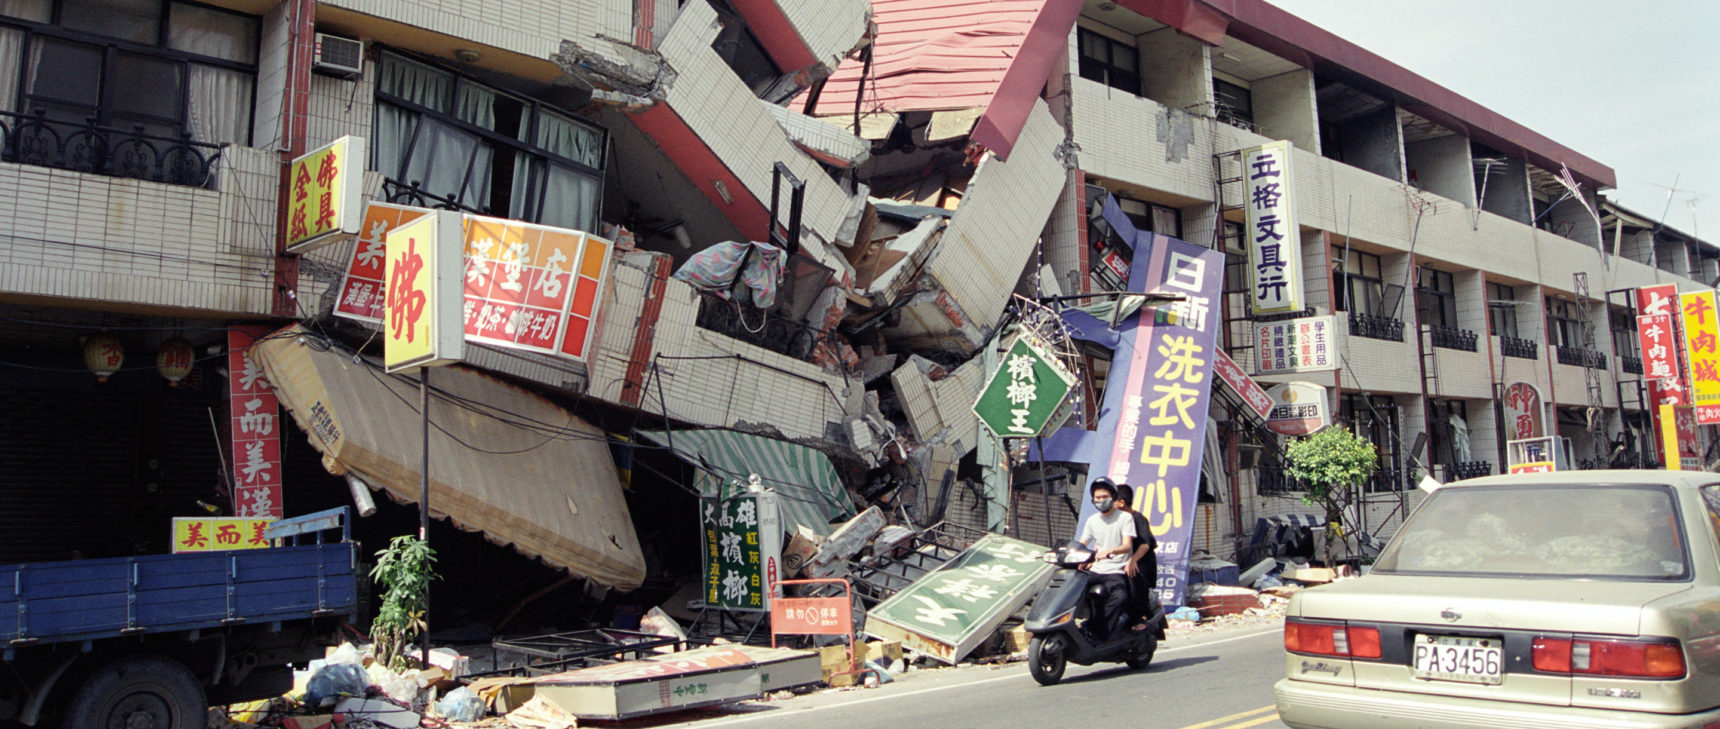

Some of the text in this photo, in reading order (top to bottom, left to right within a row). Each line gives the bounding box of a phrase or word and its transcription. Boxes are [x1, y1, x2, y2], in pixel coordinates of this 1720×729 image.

[289, 161, 312, 242] 金紙
[315, 150, 338, 232] 佛具
[1251, 153, 1288, 302] 立格文具行
[387, 237, 427, 344] 佛
[1314, 321, 1327, 366] 學生用品
[1006, 353, 1037, 434] 檳榔王
[720, 531, 748, 605] 檳榔
